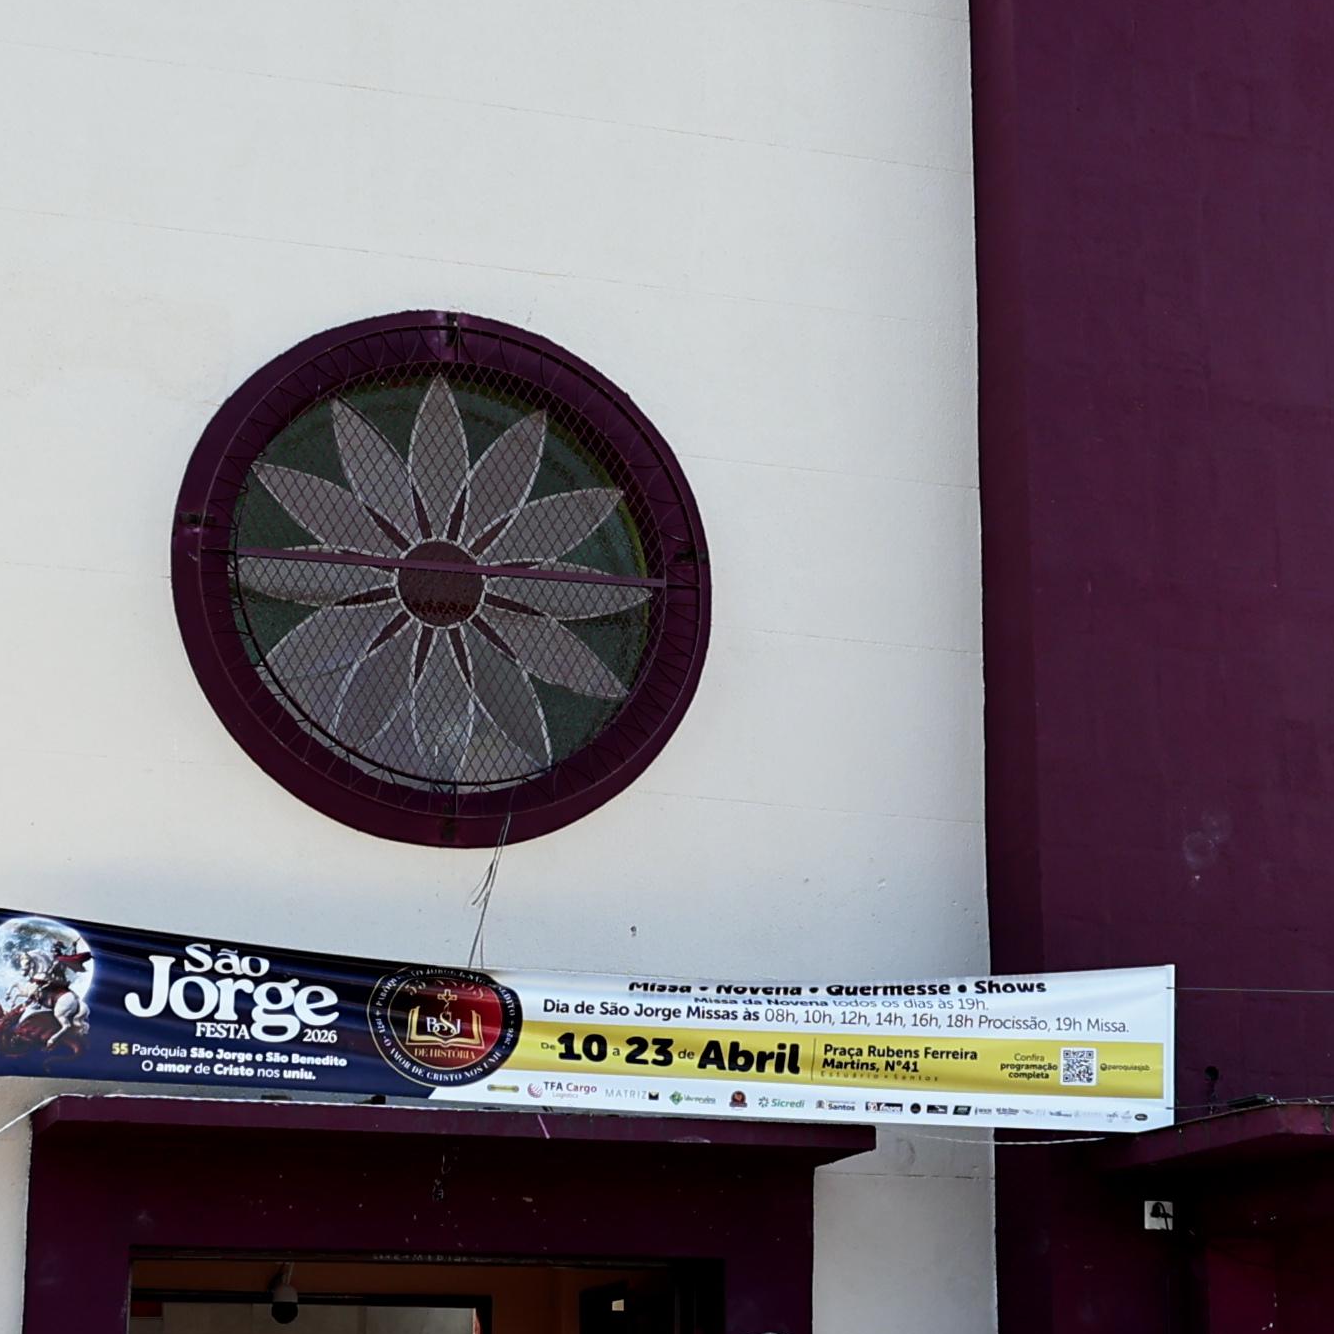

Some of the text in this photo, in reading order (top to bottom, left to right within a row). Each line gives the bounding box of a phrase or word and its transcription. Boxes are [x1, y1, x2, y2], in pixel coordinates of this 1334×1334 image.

[184, 943, 270, 977] São
[628, 980, 1047, 996] Missa Novena Quermesse Shows
[124, 955, 339, 1043] Jorge
[767, 999, 829, 1007] Novena
[832, 999, 877, 1008] todos
[881, 1000, 900, 1008] os
[904, 999, 934, 1009] dias
[938, 998, 954, 1009] às
[958, 998, 989, 1011] 19h.
[543, 999, 1130, 1033] Dia de São Jorge Missas às 08h, 10h, 12h, 14h, 16h, 18h Procissão, 19h Missa.
[195, 1022, 250, 1040] FESTA
[303, 1029, 338, 1043] 2026
[112, 1043, 347, 1067] 55 Paróquia São Jorge e São Benedito
[414, 1048, 476, 1060] DE HISTÓRIA
[541, 1033, 801, 1075] De 10 a 23 de Abril
[824, 1043, 978, 1061] Praça Rubens Ferreira
[1014, 1052, 1045, 1062] Confira
[141, 1060, 316, 1080] O amor de Cristo nos uniu.
[389, 1048, 414, 1070] AMOR
[411, 1065, 425, 1078] DE
[426, 1070, 463, 1082] CRISTO
[464, 1066, 484, 1079] NOS
[822, 1058, 880, 1073] Martins,
[1000, 1061, 1058, 1072] programação
[1008, 1071, 1050, 1080] completa
[543, 1081, 598, 1095] TFA Cargo
[604, 1088, 647, 1100] MATRIZ
[771, 1097, 805, 1108] Sicredi
[828, 1103, 856, 1112] Santos
